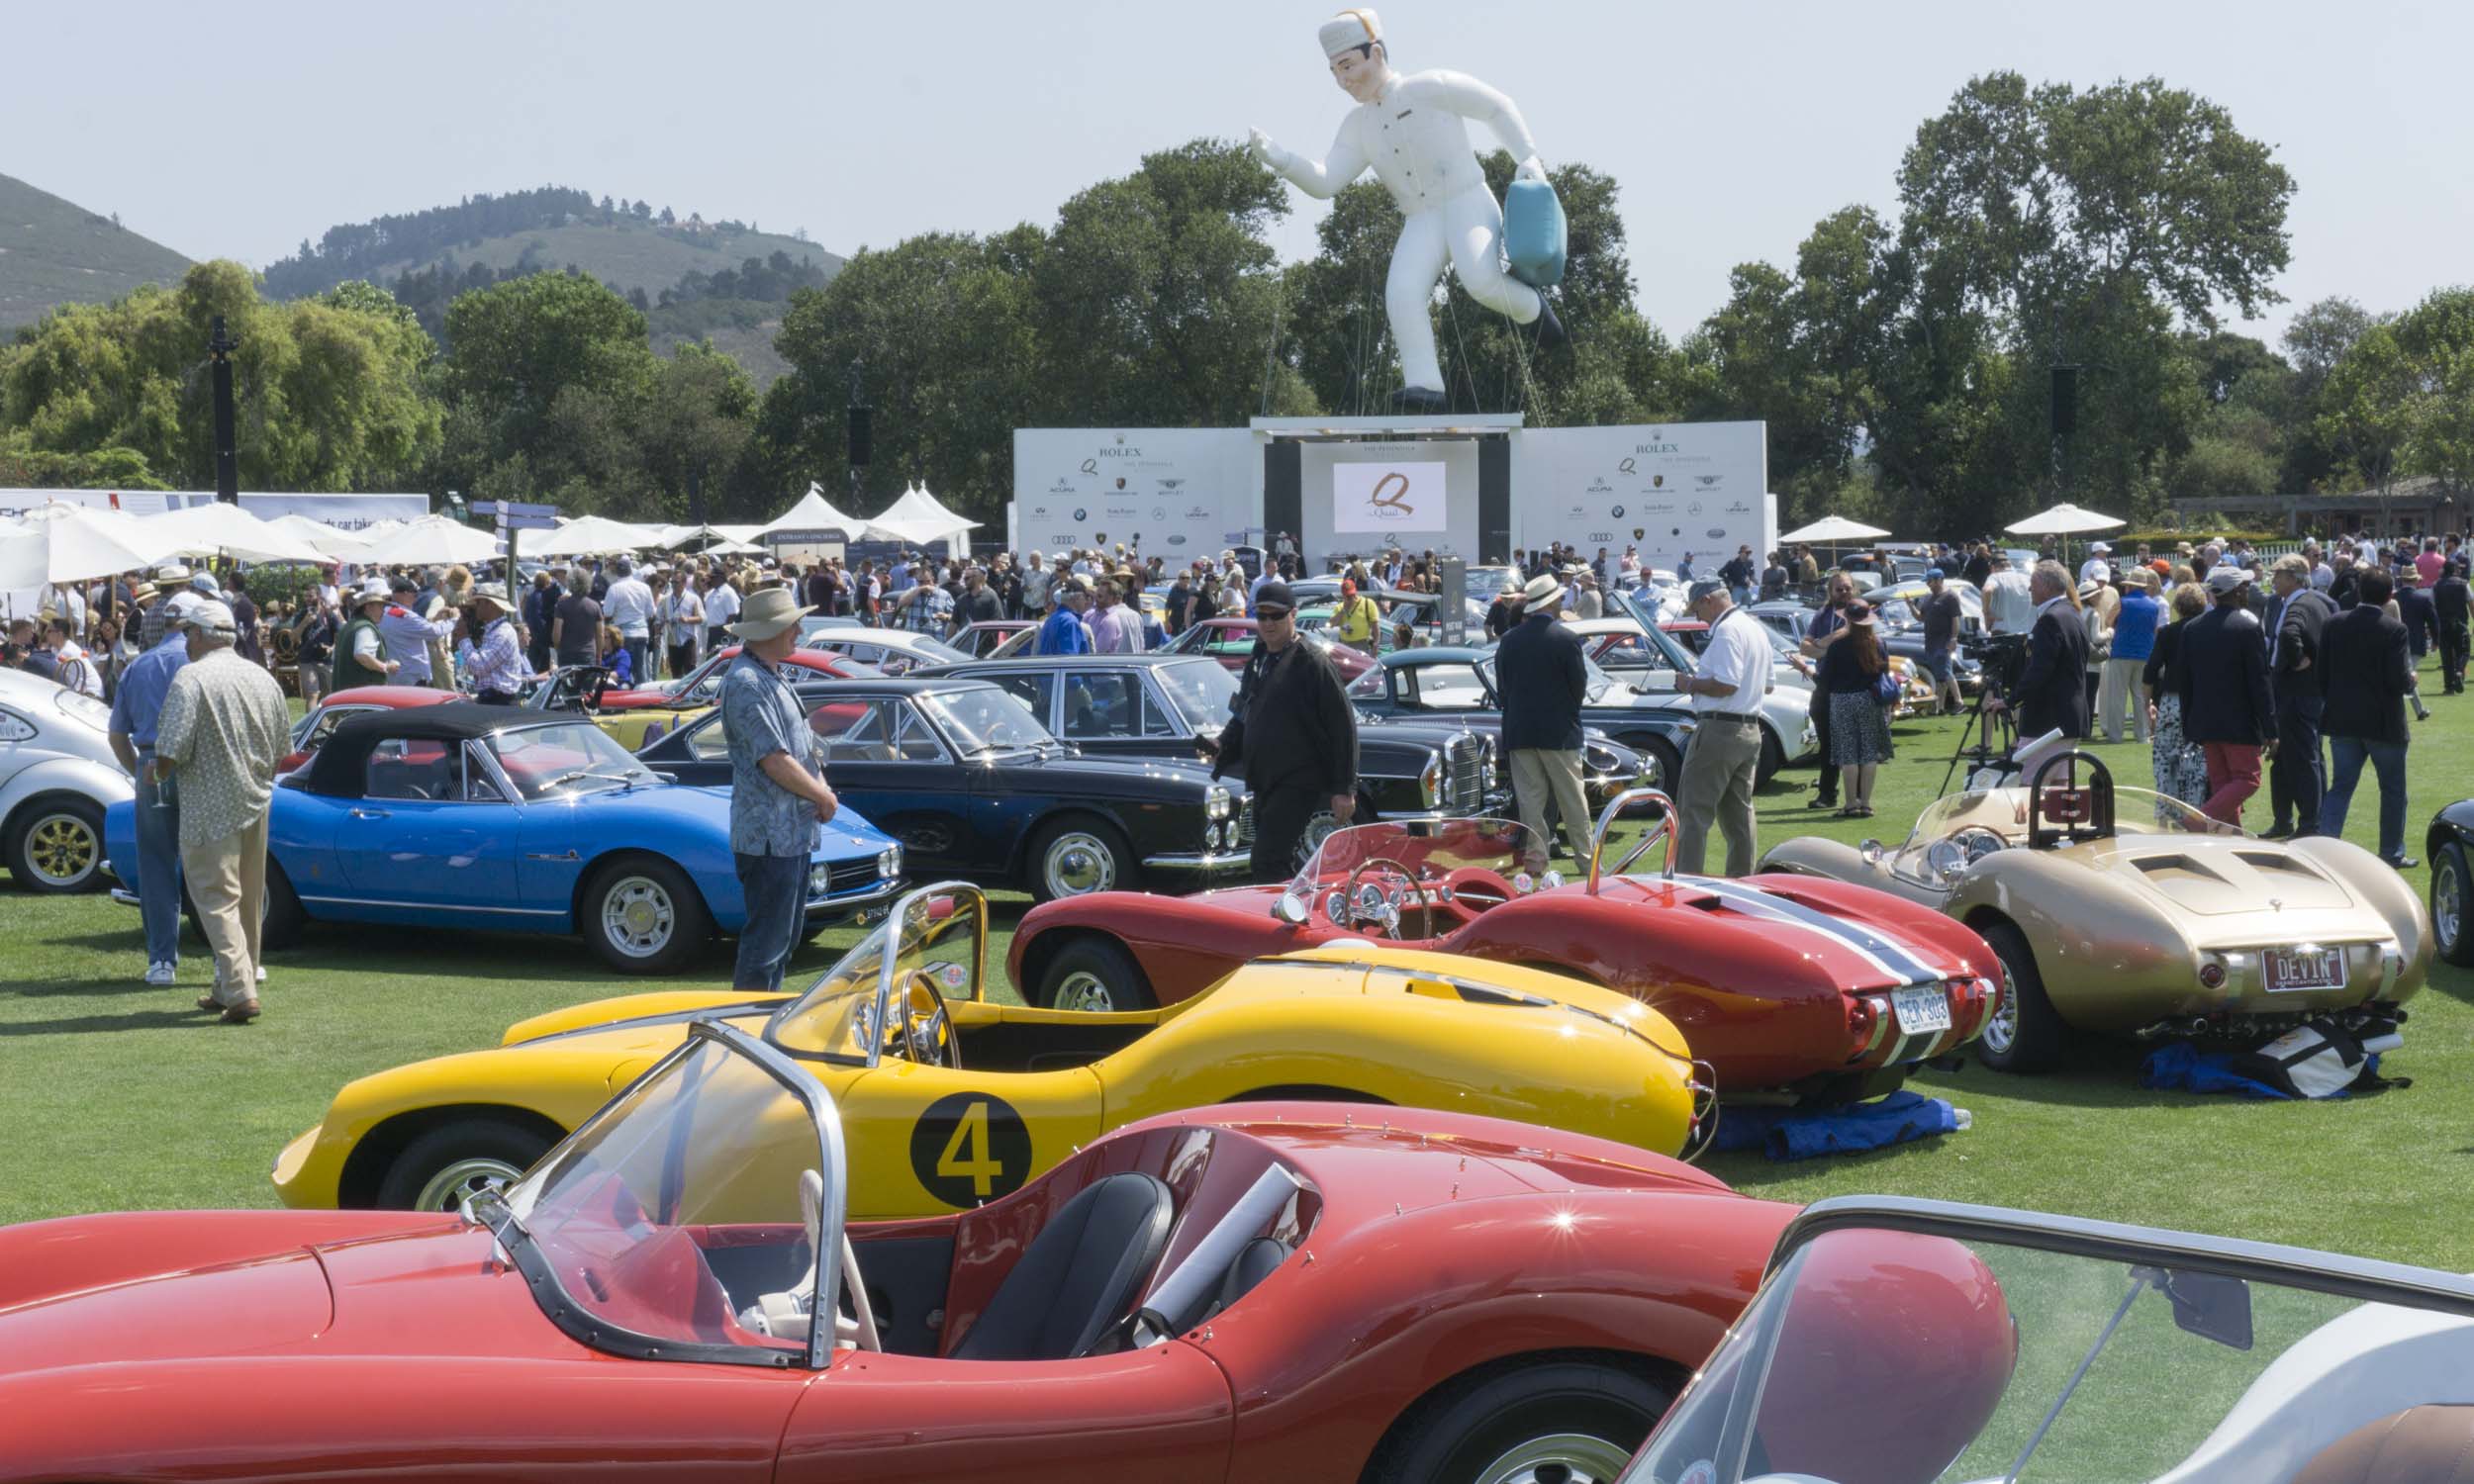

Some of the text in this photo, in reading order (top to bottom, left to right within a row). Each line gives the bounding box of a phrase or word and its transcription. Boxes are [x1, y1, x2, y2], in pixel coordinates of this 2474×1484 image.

[1099, 447, 1141, 458] ROLEX
[1636, 443, 1679, 454] ROLEX
[2278, 958, 2331, 980] DEVIN
[936, 1101, 1002, 1196] 4
